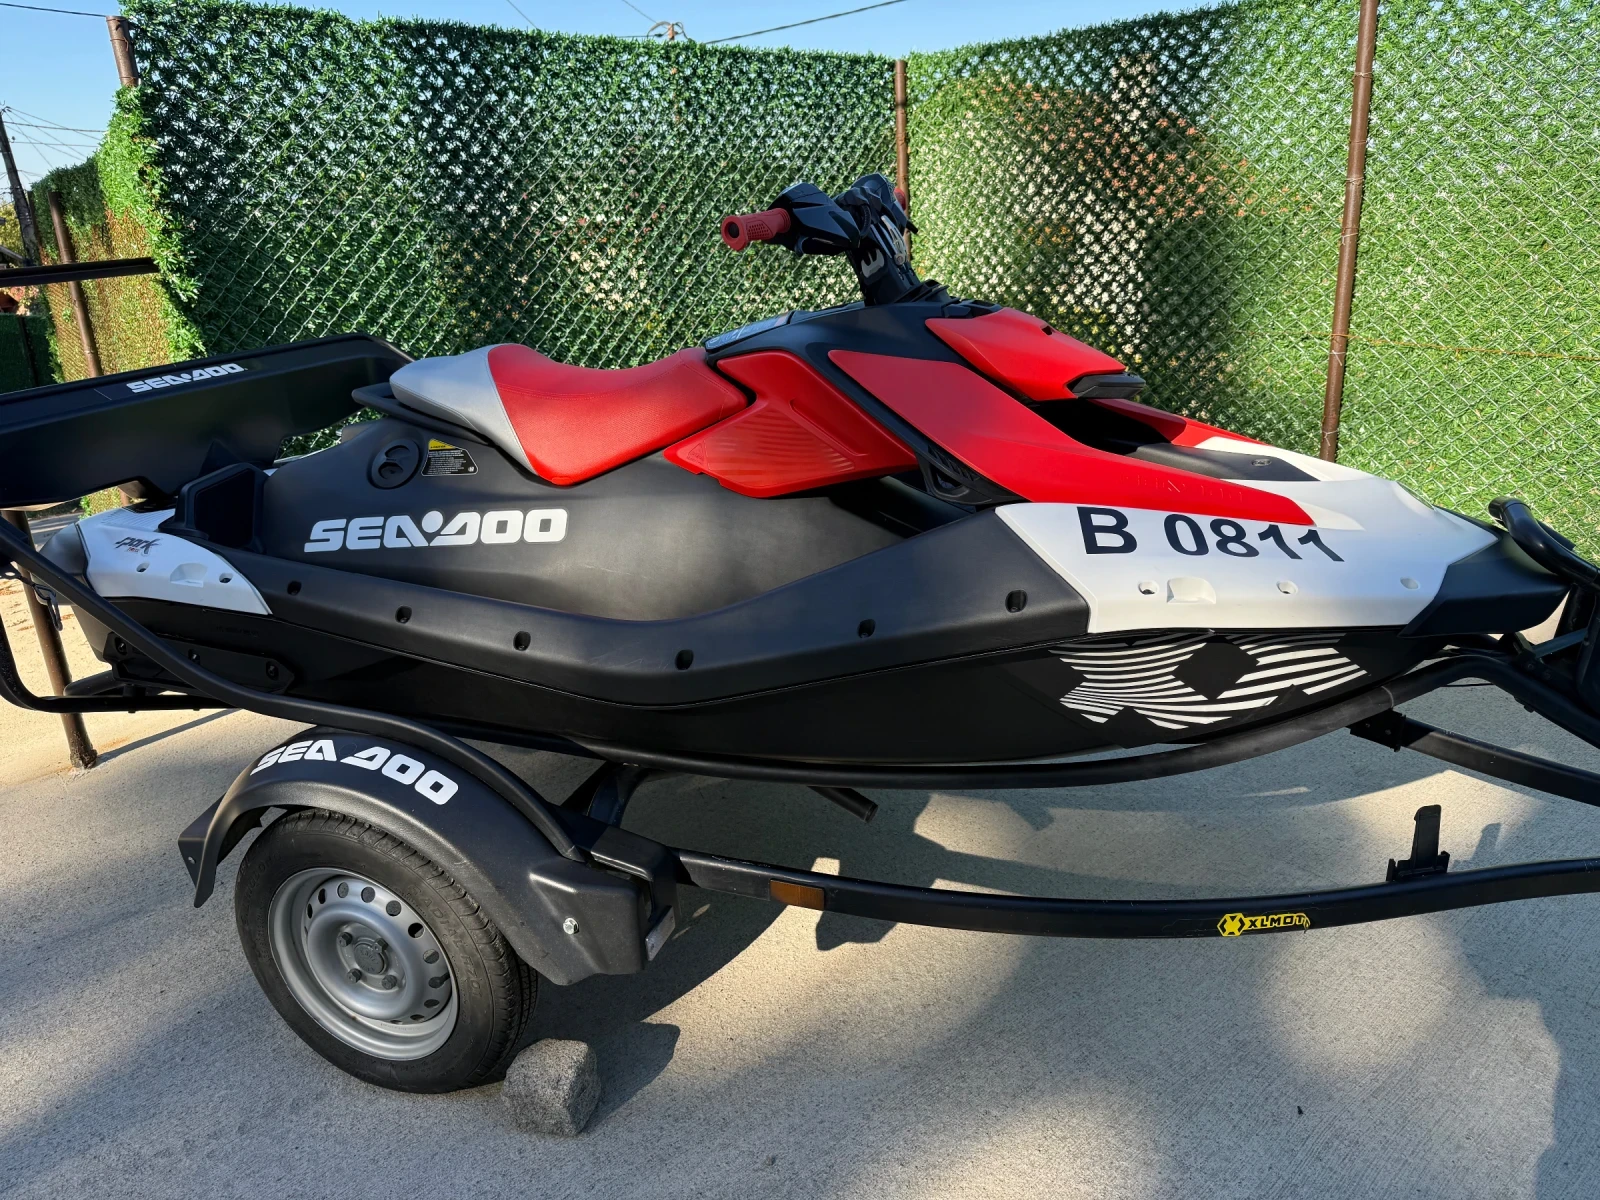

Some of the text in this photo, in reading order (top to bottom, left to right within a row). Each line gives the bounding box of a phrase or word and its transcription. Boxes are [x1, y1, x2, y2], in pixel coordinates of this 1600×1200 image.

[1077, 506, 1345, 562] B 0811
[250, 739, 459, 806] SEA DOO
